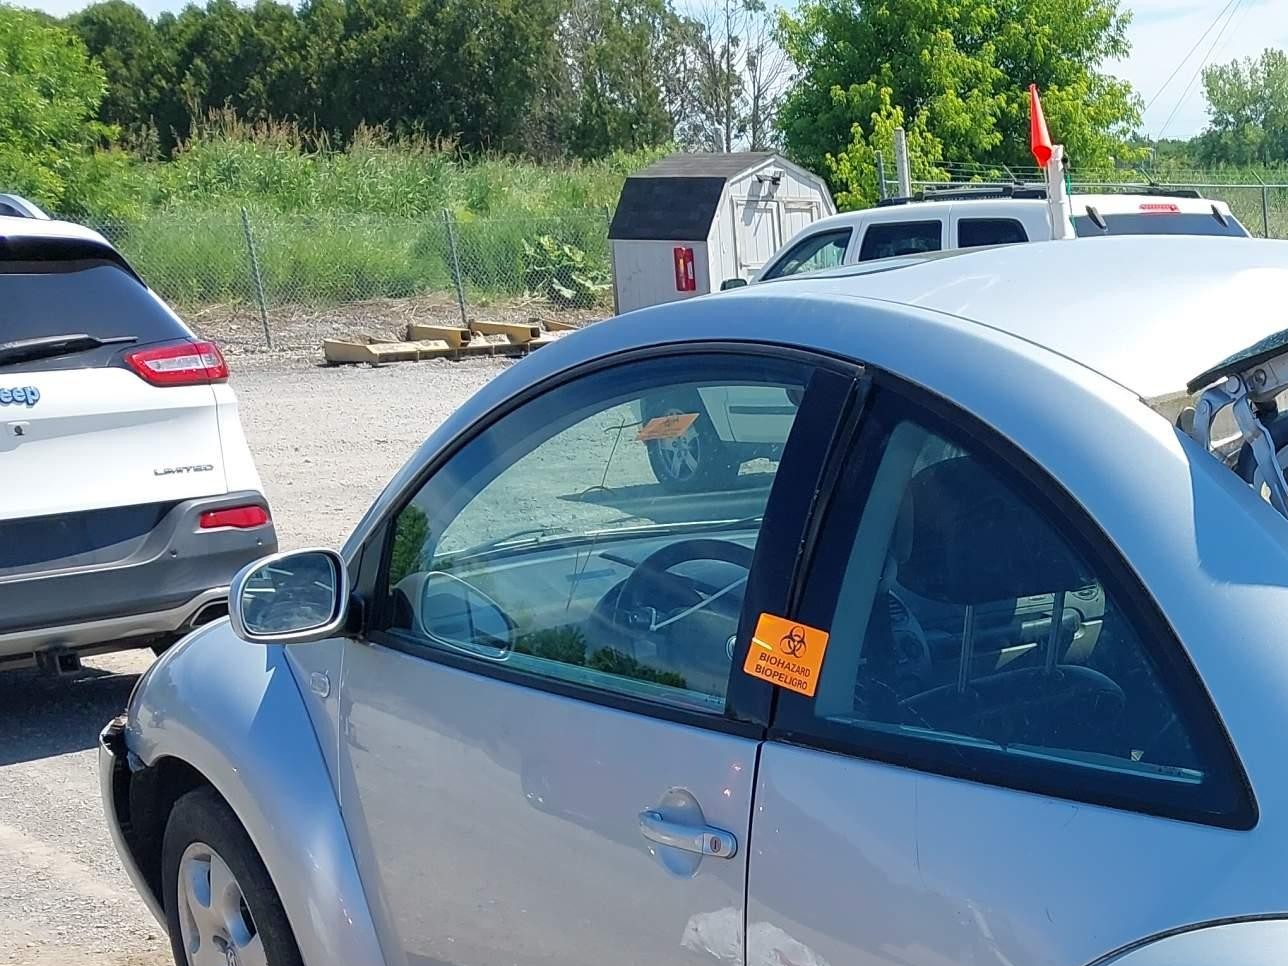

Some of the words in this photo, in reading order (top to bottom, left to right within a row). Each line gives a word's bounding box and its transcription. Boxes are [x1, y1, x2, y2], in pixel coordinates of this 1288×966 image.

[0, 386, 40, 407] eep
[754, 663, 808, 690] BIOPELIGRO
[759, 652, 811, 677] BIOHAZARD
